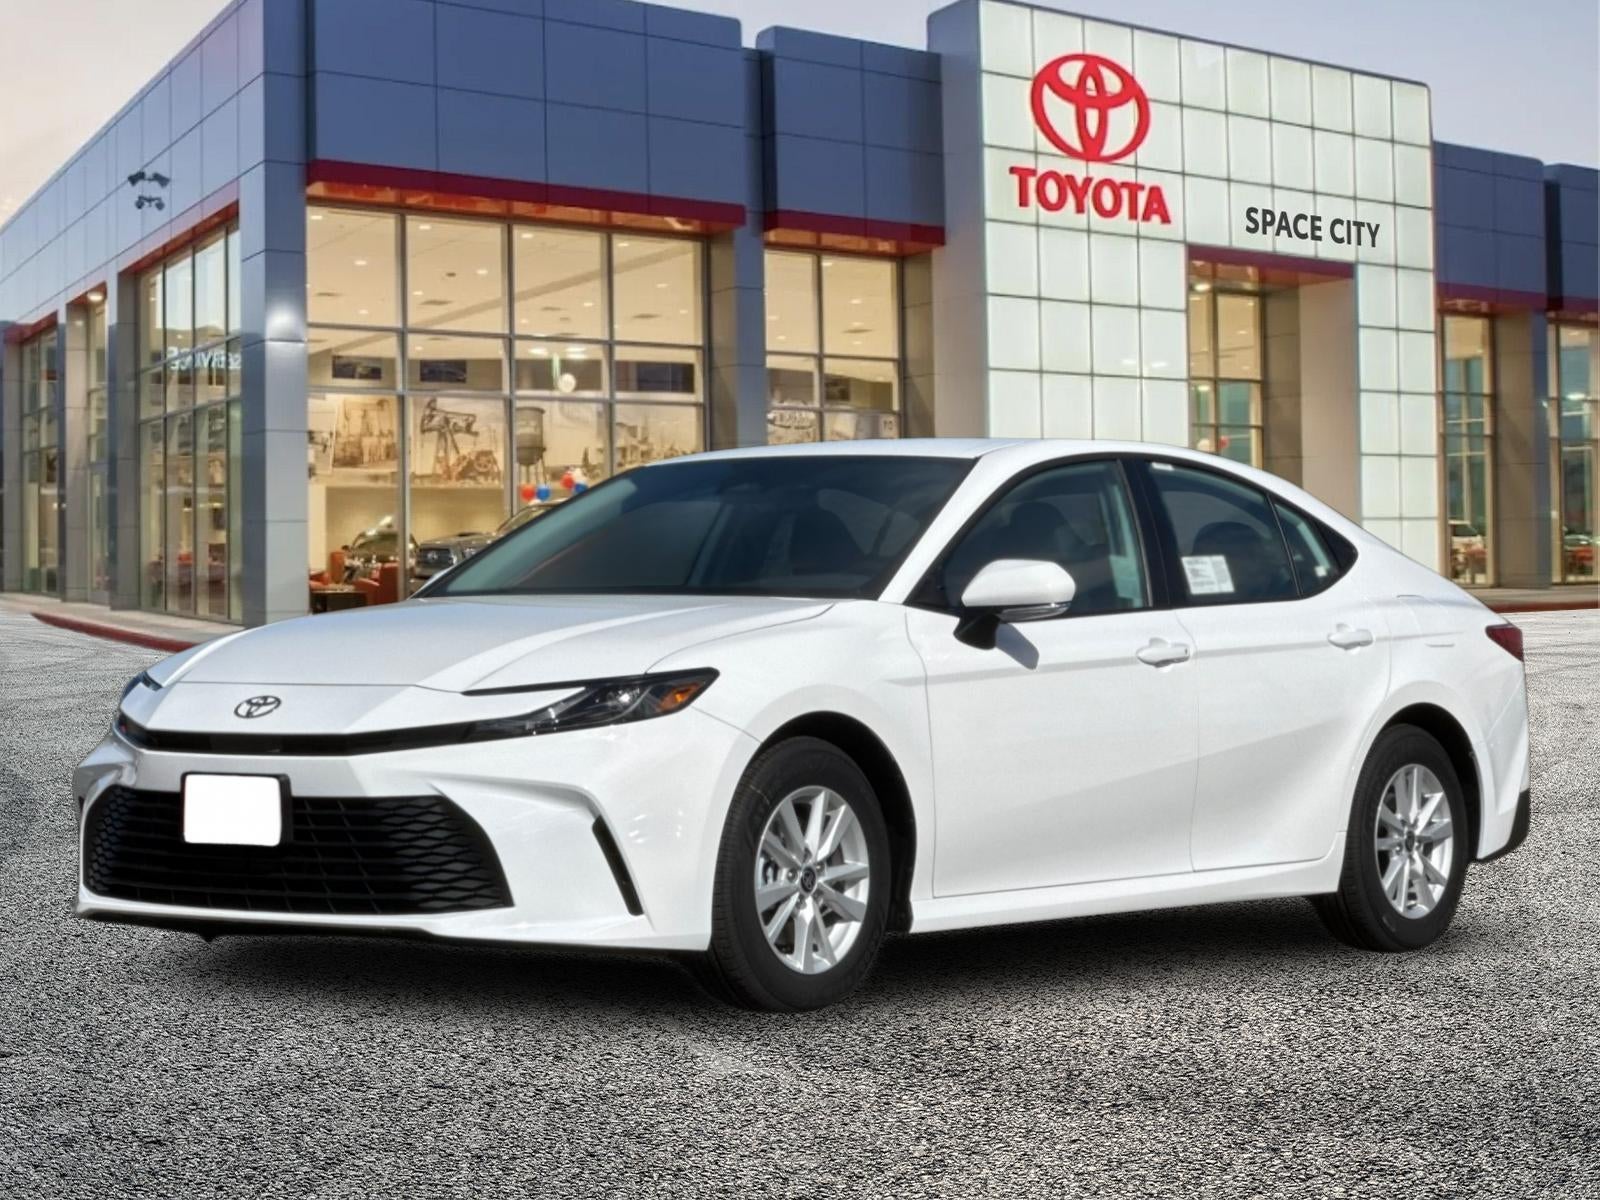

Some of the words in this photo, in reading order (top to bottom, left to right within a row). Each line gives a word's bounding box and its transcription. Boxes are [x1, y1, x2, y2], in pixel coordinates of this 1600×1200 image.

[1009, 166, 1171, 224] TOYOTA
[1245, 206, 1323, 242] SPACE
[1329, 217, 1381, 248] CITY
